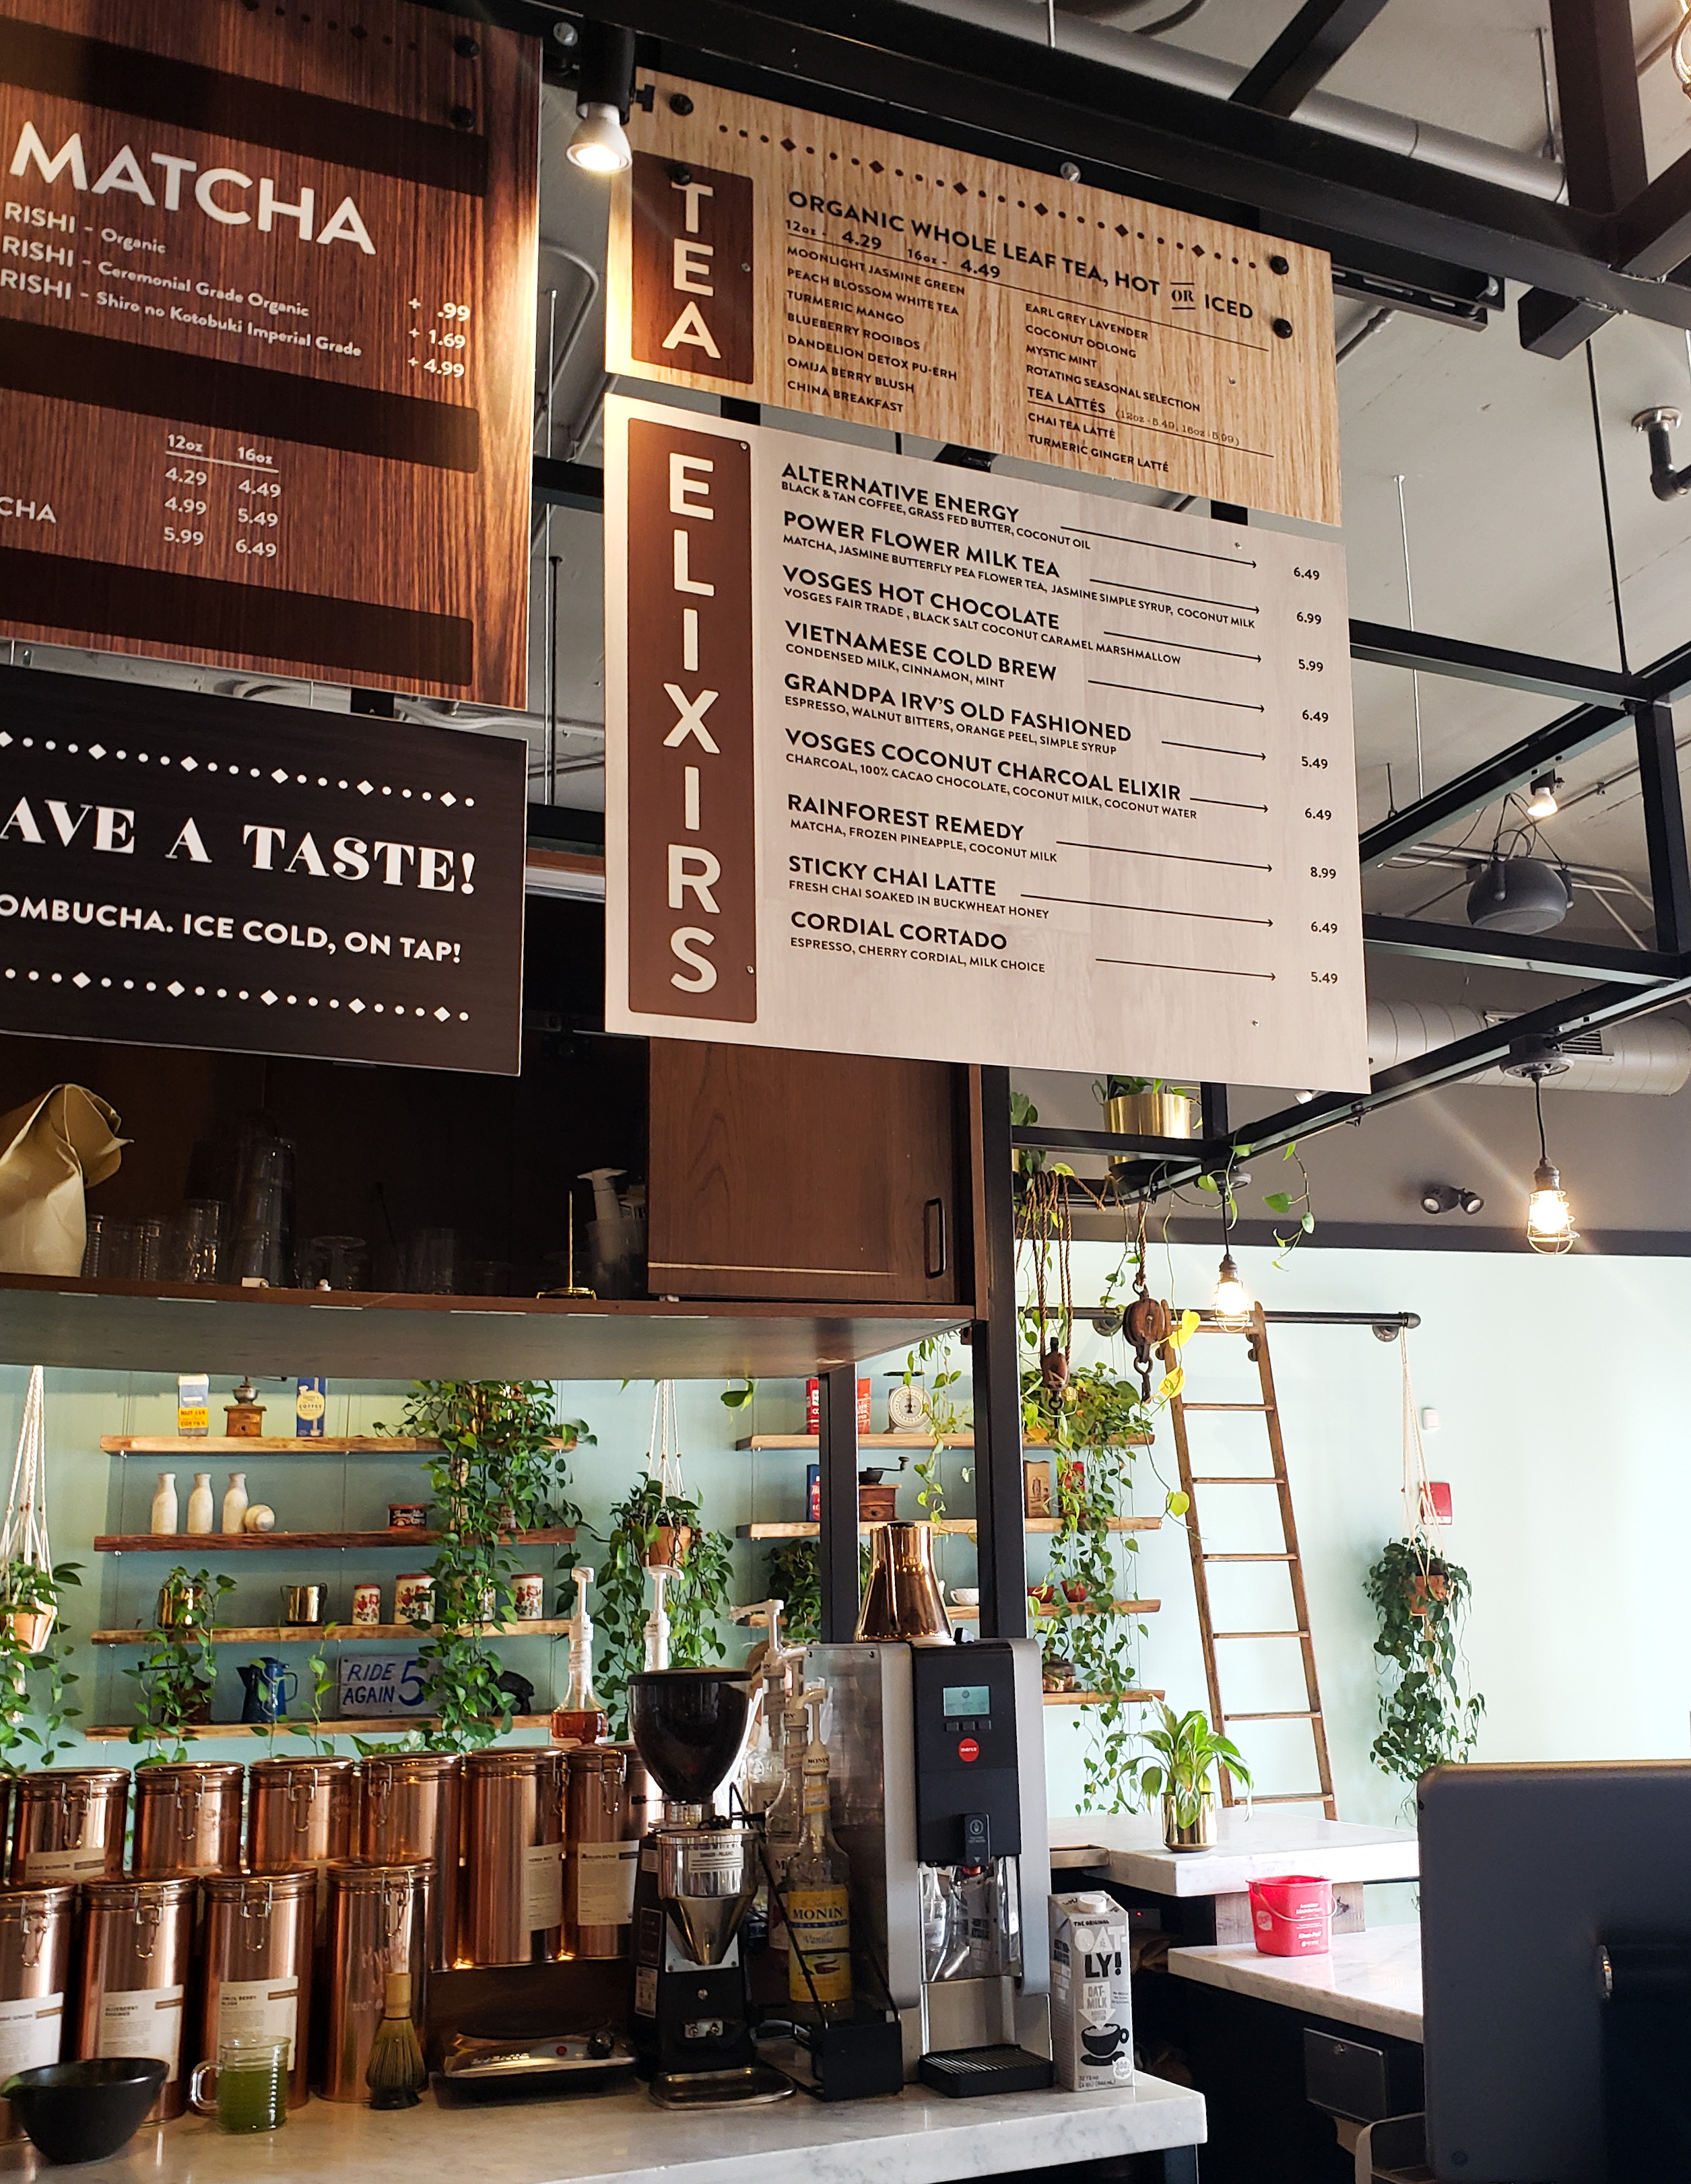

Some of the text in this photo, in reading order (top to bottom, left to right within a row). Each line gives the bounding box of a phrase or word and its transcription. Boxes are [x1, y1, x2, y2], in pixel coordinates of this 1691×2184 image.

[9, 121, 376, 255] MATCHA
[4, 201, 166, 254] RISHI Organic
[786, 220, 1000, 279] 12oz 4.29 16oz 4.49
[789, 192, 1253, 318] ORGANIC WHOLE LEAF TEA, HOT OR ICED
[3, 235, 309, 316] RISHI Ceremonial Grade Organic
[661, 182, 721, 359] TEA
[787, 246, 965, 296] MOONLIGHT JASMINE GREEN
[787, 267, 959, 316] PEACH BLOSSOM WHITE TEA
[787, 289, 904, 324] TURMERIC MANGO
[0, 268, 362, 356] RISHI Shiro no Kotobuki Imperial Grade
[1025, 303, 1148, 341] EARL GREY LAVENDER
[428, 329, 465, 349] 1.69
[787, 313, 920, 350] BLUEBERRY ROOIBOS
[1025, 325, 1136, 358] COCONUT OOLONG
[424, 358, 465, 378] 4.99
[787, 335, 957, 381] DANDELION DETOX PU-ERH
[1026, 344, 1098, 368] MYSTIC MINT
[787, 357, 915, 394] OMIJA BERRY BLUSH
[1026, 364, 1200, 412] ROTATING SEASONAL SELECTION
[787, 380, 903, 413] CHINA BREAKFAST
[1026, 386, 1106, 414] TEA LATTÉS
[1028, 413, 1115, 440] CHAI TEA LATTÉ
[168, 434, 273, 465] 12oz 16oz
[1028, 434, 1169, 473] TURMERIC GINGER LATTÉ
[165, 467, 281, 498] 4.29 4.49
[781, 463, 1020, 523] ALTERNATIVE ENERGY
[164, 496, 278, 527] 4.99 5.49
[164, 526, 277, 557] 5.99 6.49
[784, 510, 1060, 578] POWER FLOWER MILK TEA
[1294, 567, 1320, 580] 6.49
[783, 564, 1059, 630] VOSGES HOT CHOCOLATE
[1296, 611, 1322, 625] 6.99
[785, 620, 1057, 681] VIETNAMESE COLD BREW
[786, 643, 1004, 688] CONDENSED MILK, CINNAMON, MINT
[1298, 658, 1323, 673] 5.99
[663, 452, 721, 993] ELIXIRS
[785, 673, 1131, 741] GRANDPA IRV'S OLD FASHIONED
[1302, 709, 1329, 723] 6.49
[785, 728, 1181, 801] VOSGES COCONUT CHARCOAL ELIXIR
[1301, 755, 1328, 770] 5.49
[788, 794, 1024, 841] RAINFOREST REMEDY
[1304, 807, 1332, 821] 6.49
[0, 796, 475, 895] AVE A TASTE!
[791, 819, 1057, 862] MATCHA, FROZEN PINEAPPLE, COCONUT MILK
[789, 855, 996, 896] STICKY CHAI LATTE
[1310, 866, 1337, 879] 8.99
[789, 879, 1049, 919] FRESH CHAI SOAKED IN BUCKWHEAT HONEY
[184, 914, 234, 939] ICE
[242, 920, 336, 955] COLD,
[344, 931, 391, 956] ON
[399, 936, 461, 963] TAP!
[791, 911, 1007, 950] CORDIAL CORTADO
[1311, 921, 1337, 934] 6.49
[791, 937, 1045, 973] ESPRESSO, CHERRY CORDIAL, MILK CHOICE
[1311, 971, 1338, 984] 5.49
[347, 1664, 396, 1682] RIDE
[342, 1686, 395, 1705] AGAIN
[793, 1907, 843, 1920] MONIN
[802, 1931, 834, 1944] Vanilla
[1085, 1952, 1121, 1978] LY!
[1087, 1998, 1107, 2009] MILK
